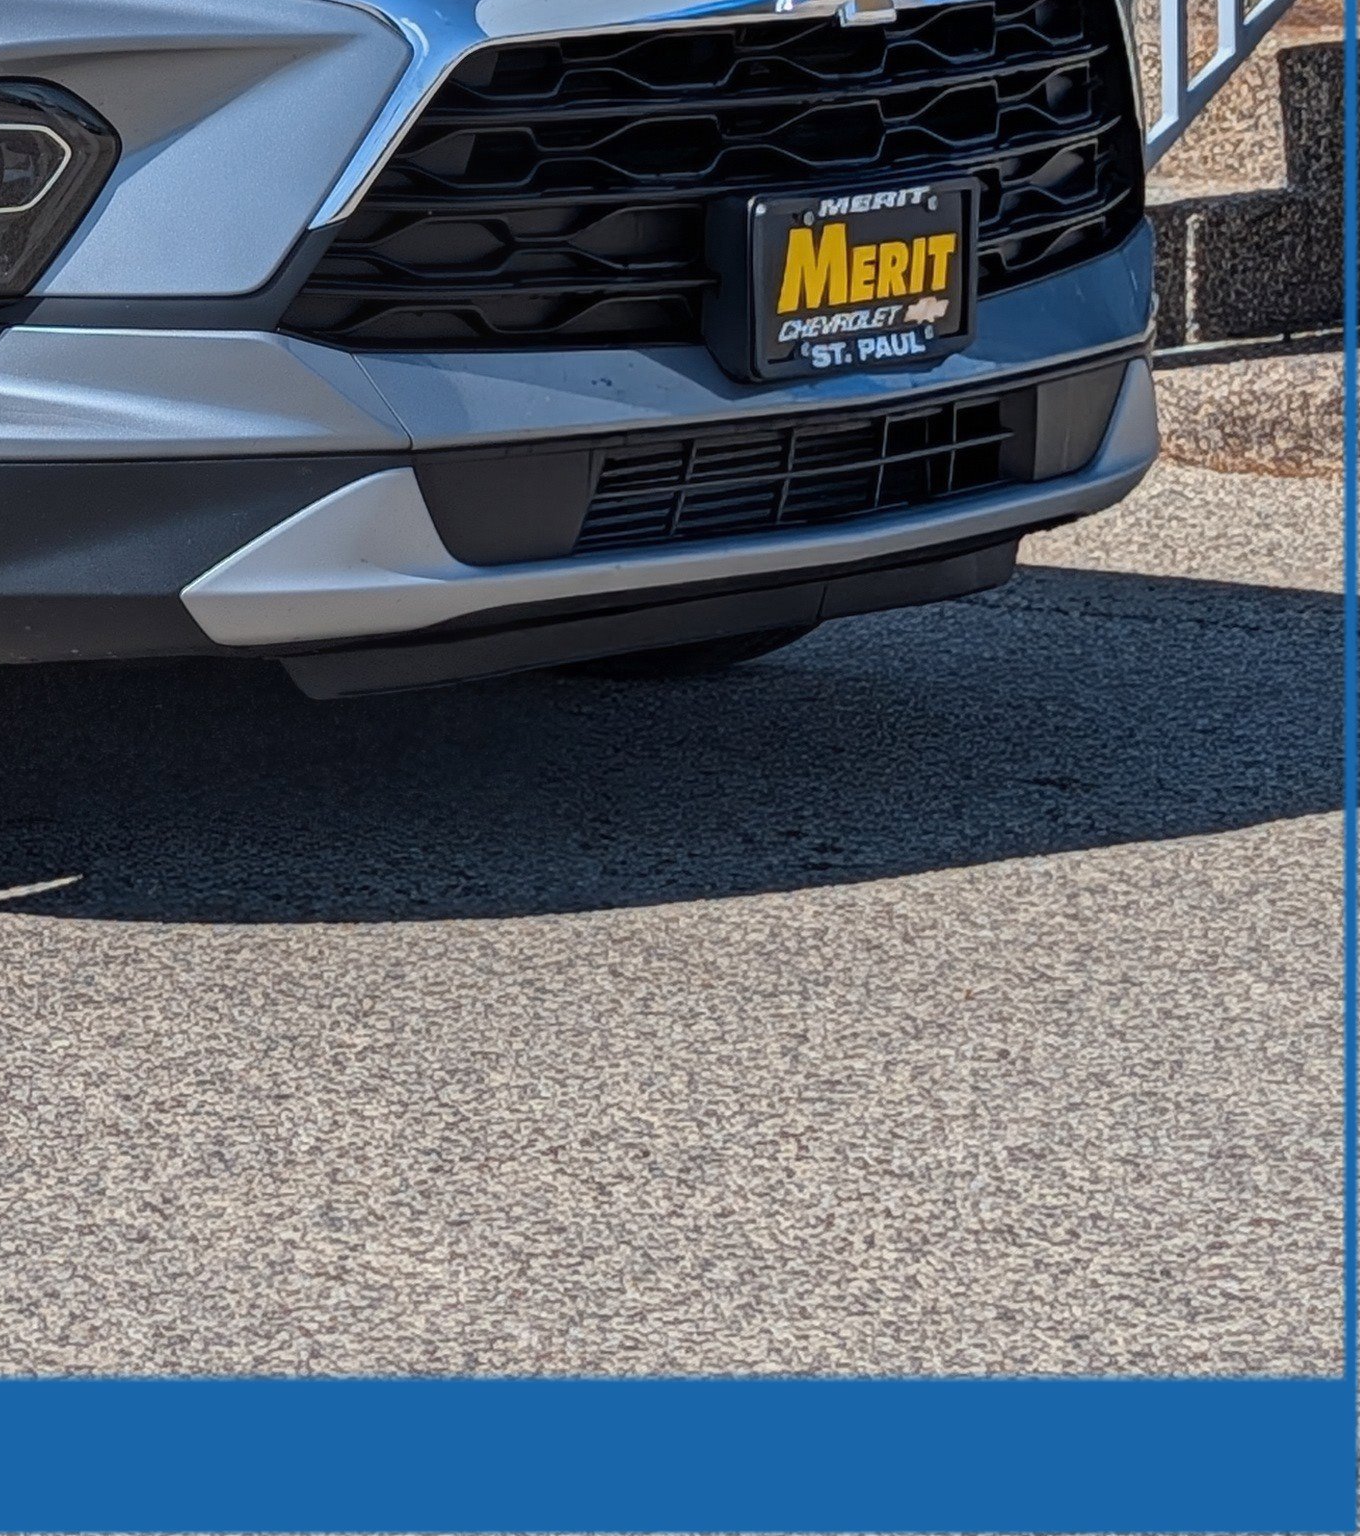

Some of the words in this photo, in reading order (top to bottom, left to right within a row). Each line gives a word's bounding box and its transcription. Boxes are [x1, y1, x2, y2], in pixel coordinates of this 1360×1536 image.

[817, 184, 931, 218] MERIT
[776, 222, 958, 315] MERIT
[777, 303, 904, 343] CHEVROLET
[811, 341, 852, 369] ST.
[857, 331, 927, 363] PAUL
